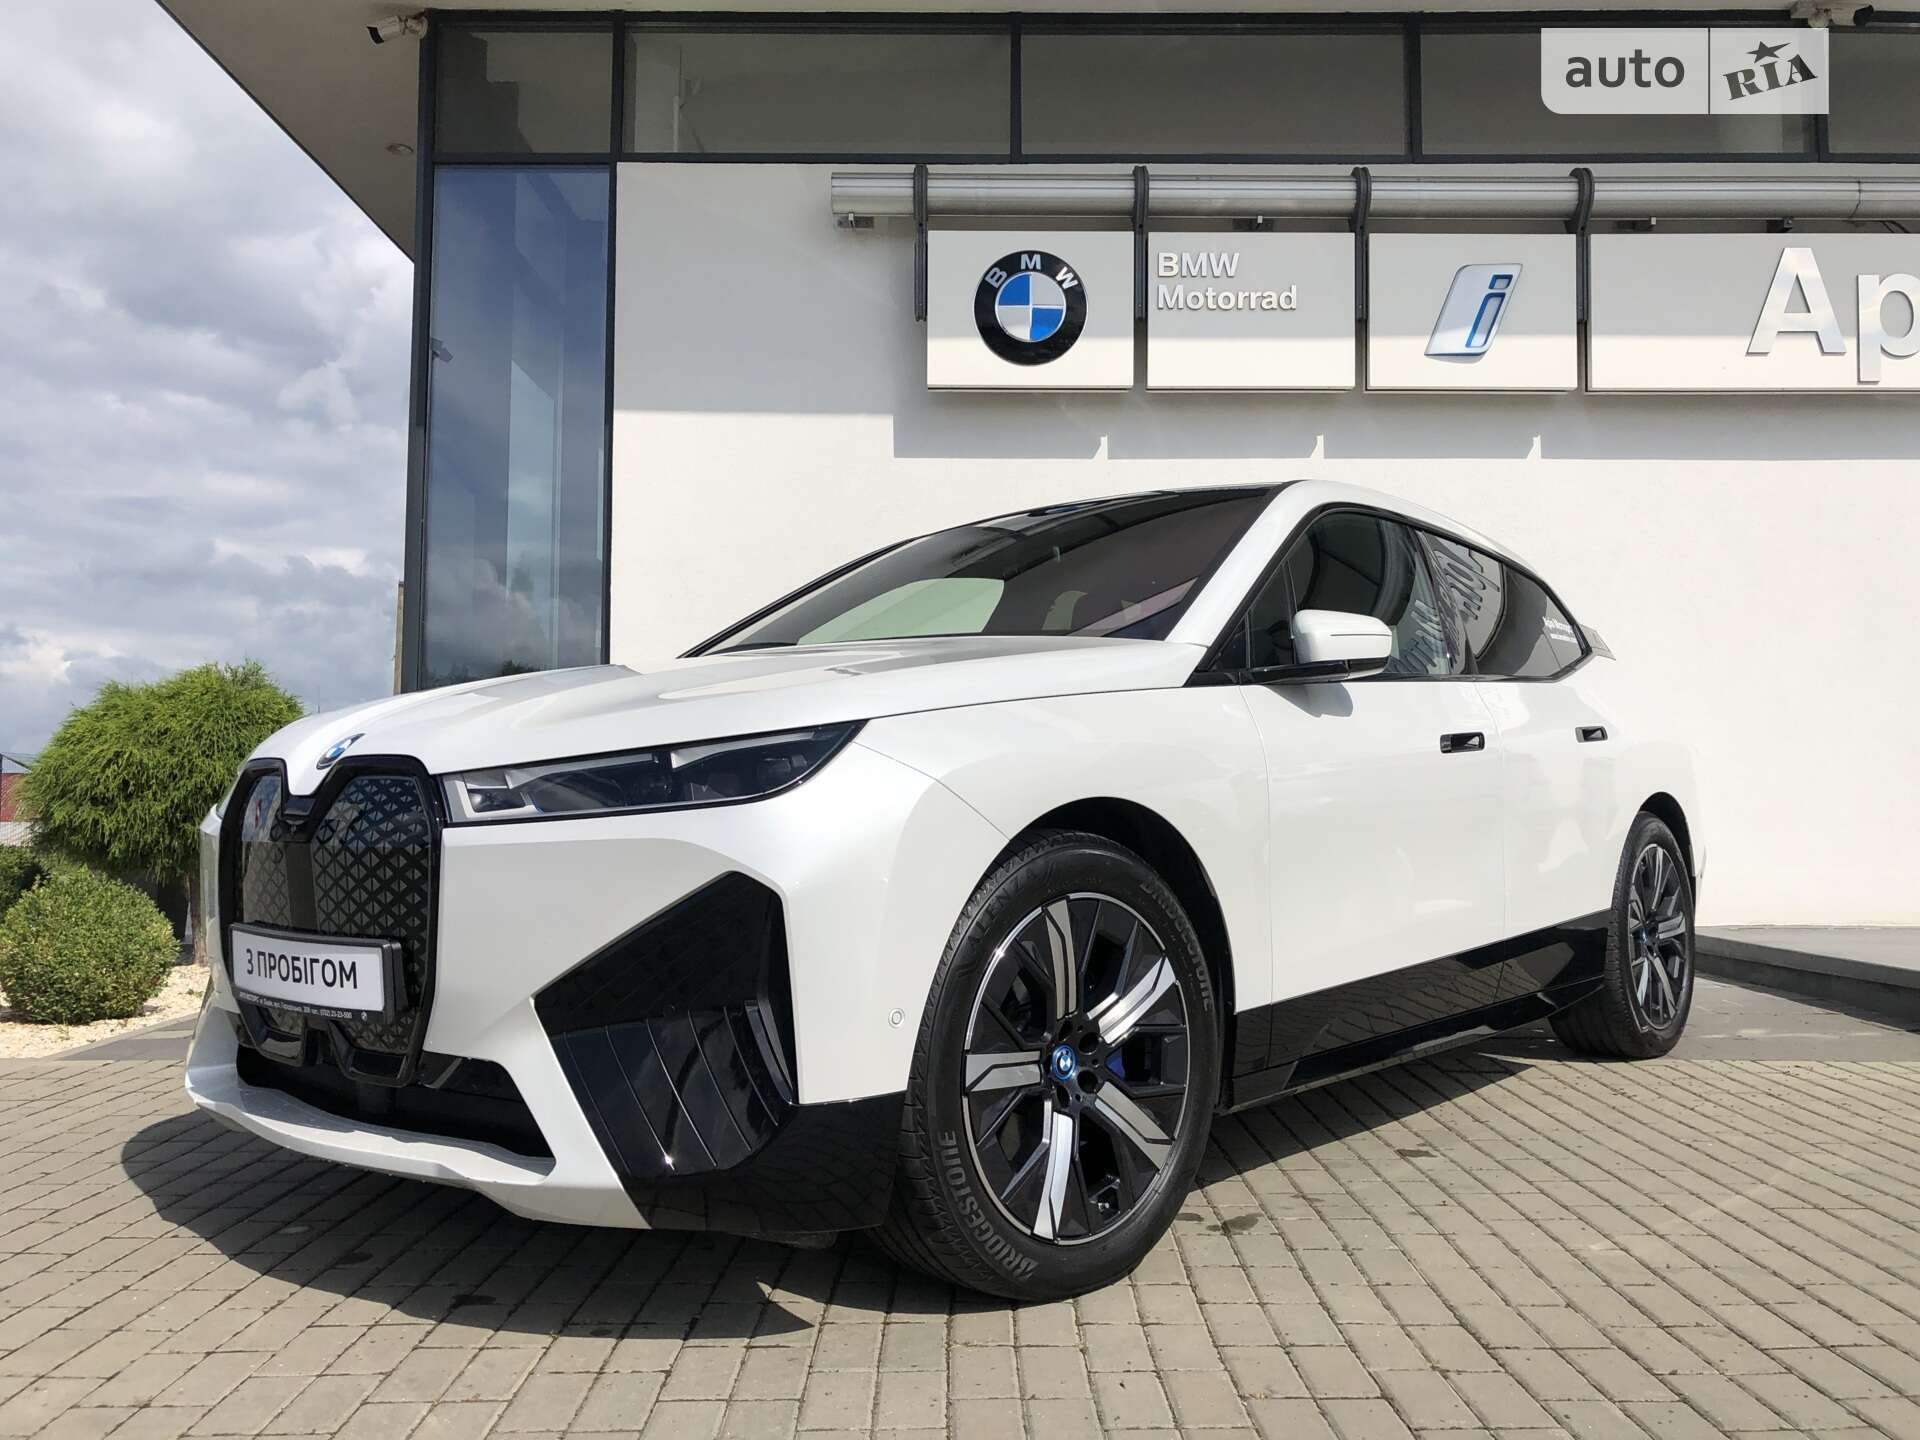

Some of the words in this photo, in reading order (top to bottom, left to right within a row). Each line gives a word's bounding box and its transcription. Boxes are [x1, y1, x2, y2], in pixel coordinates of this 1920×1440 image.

[985, 254, 1079, 290] BMW
[1157, 252, 1240, 278] BMW
[1157, 284, 1297, 311] Motorrad
[257, 950, 357, 989] ПРОБІГОМ
[939, 1131, 1039, 1279] BRIDGESTONE
